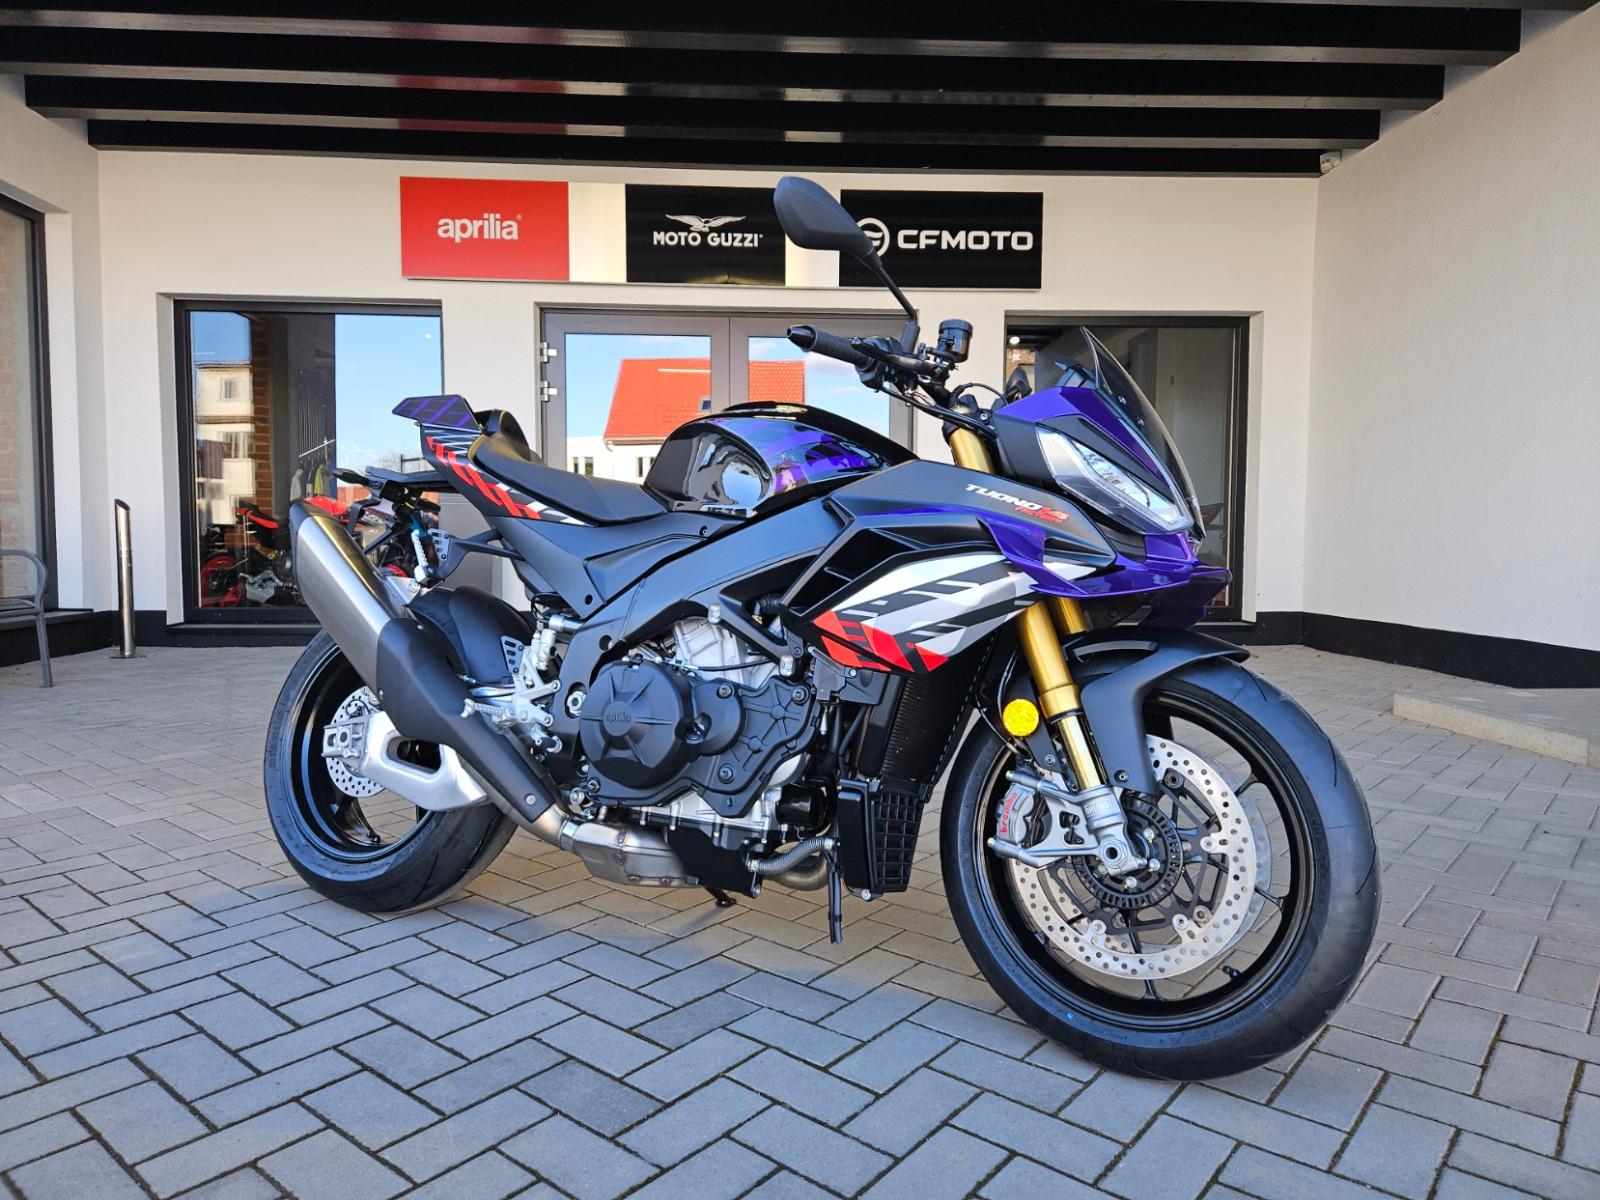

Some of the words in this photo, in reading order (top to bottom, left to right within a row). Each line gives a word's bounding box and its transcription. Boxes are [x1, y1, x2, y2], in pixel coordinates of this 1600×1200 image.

[437, 213, 519, 243] aprilia
[653, 231, 701, 246] MOTO
[707, 232, 759, 247] GUZZI
[897, 229, 1034, 251] CFMOTO
[965, 484, 1043, 511] TUONO
